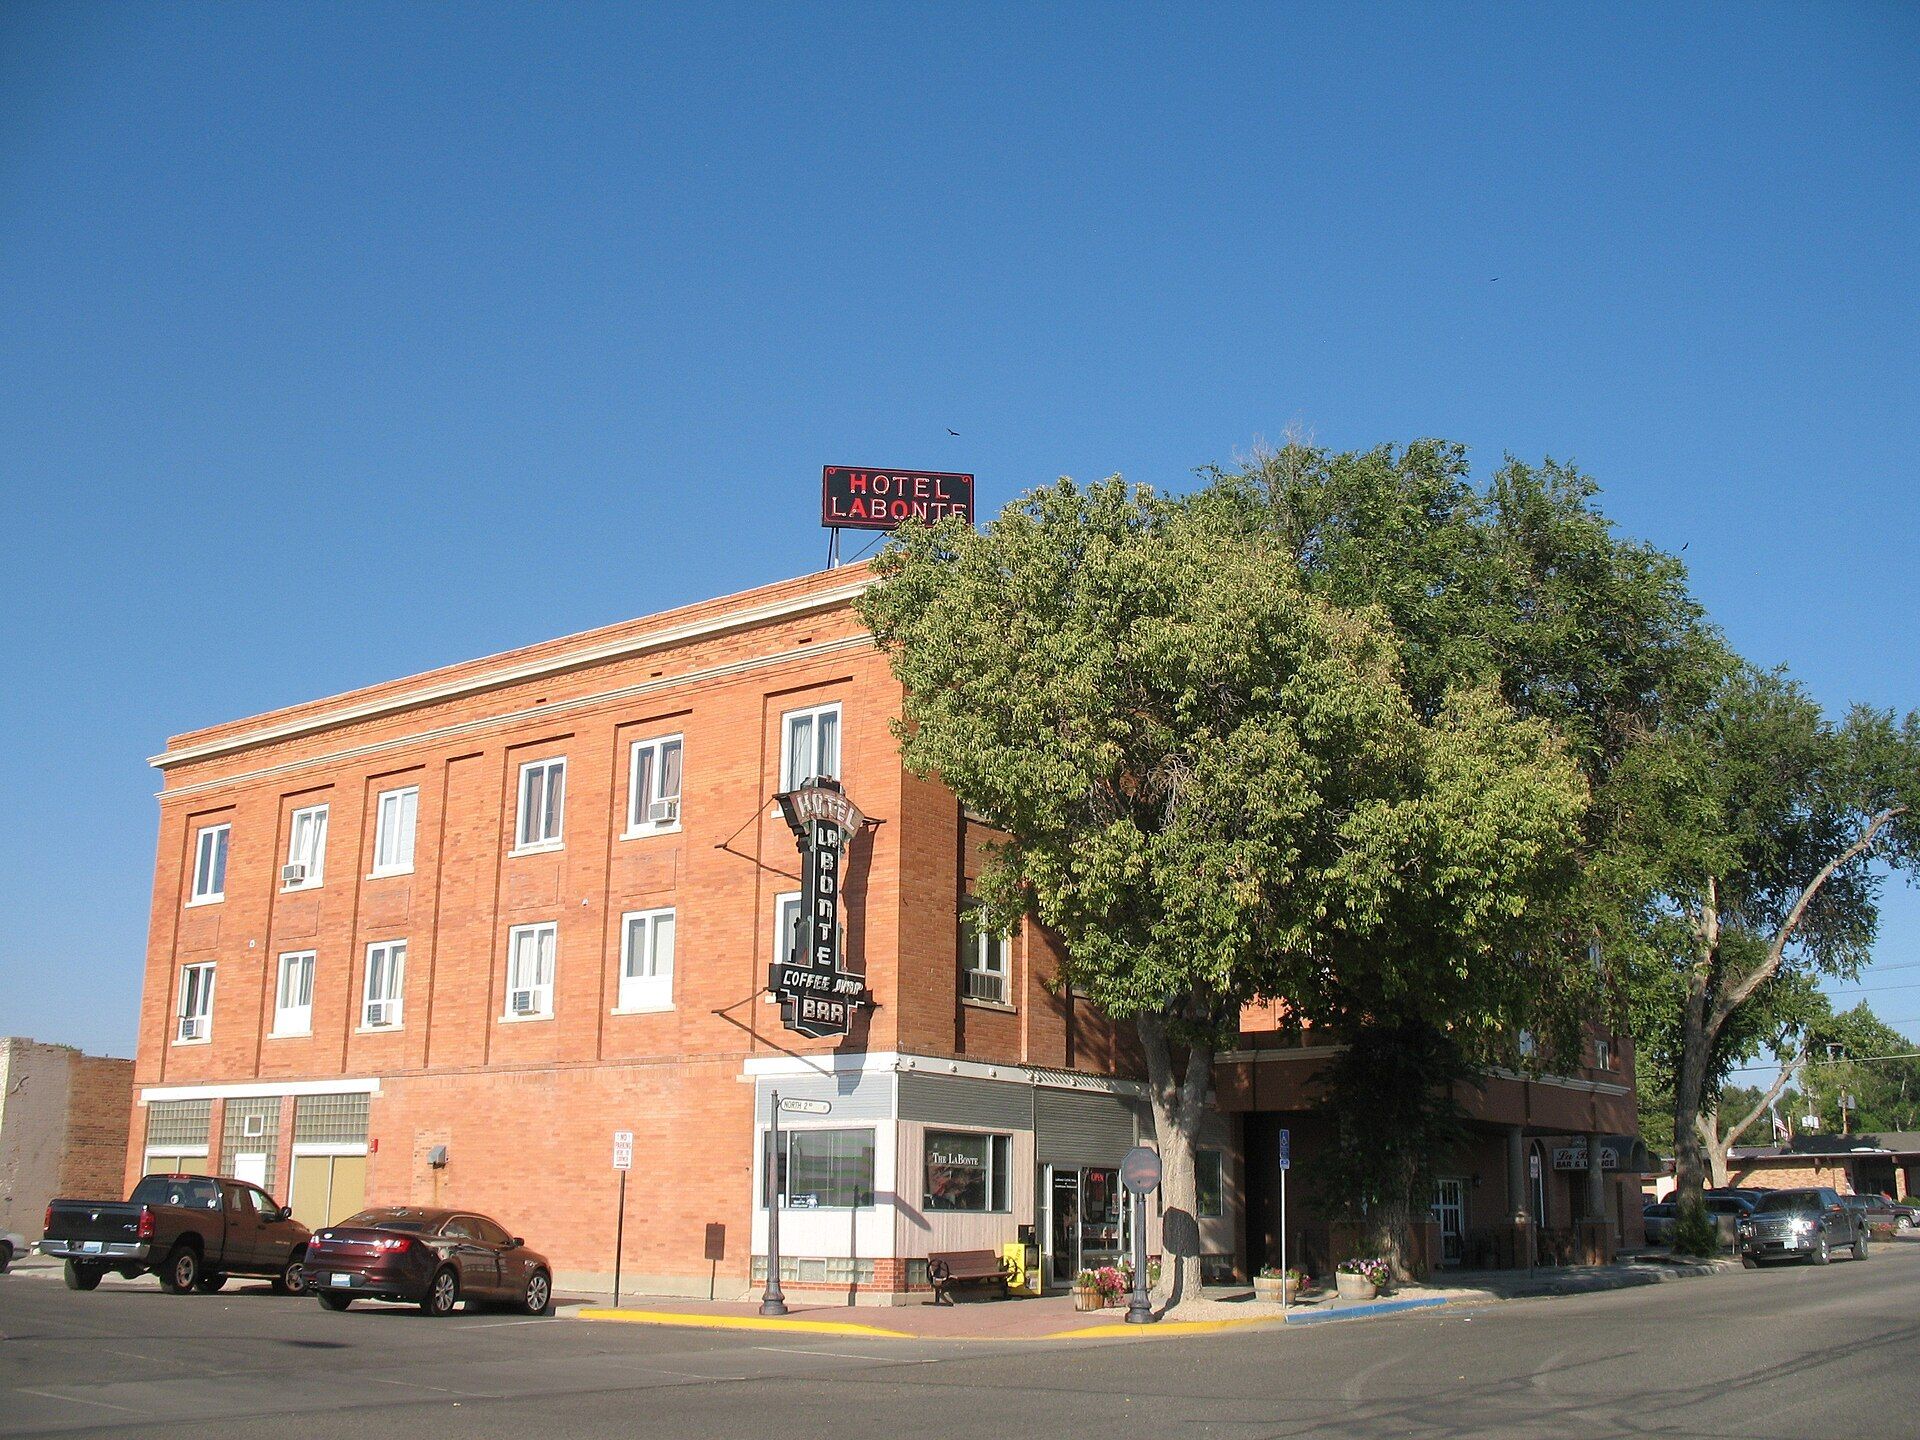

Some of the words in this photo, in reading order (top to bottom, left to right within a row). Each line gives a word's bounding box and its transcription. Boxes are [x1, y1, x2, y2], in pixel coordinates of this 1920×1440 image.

[849, 473, 951, 500] HOTEL
[831, 496, 967, 522] LABONTE
[796, 791, 855, 831] HOTEL
[783, 970, 831, 991] COFFEE
[832, 978, 864, 996] SHOP
[803, 998, 844, 1023] BAR
[783, 1100, 802, 1110] NORTH
[1555, 1160, 1572, 1168] BAR
